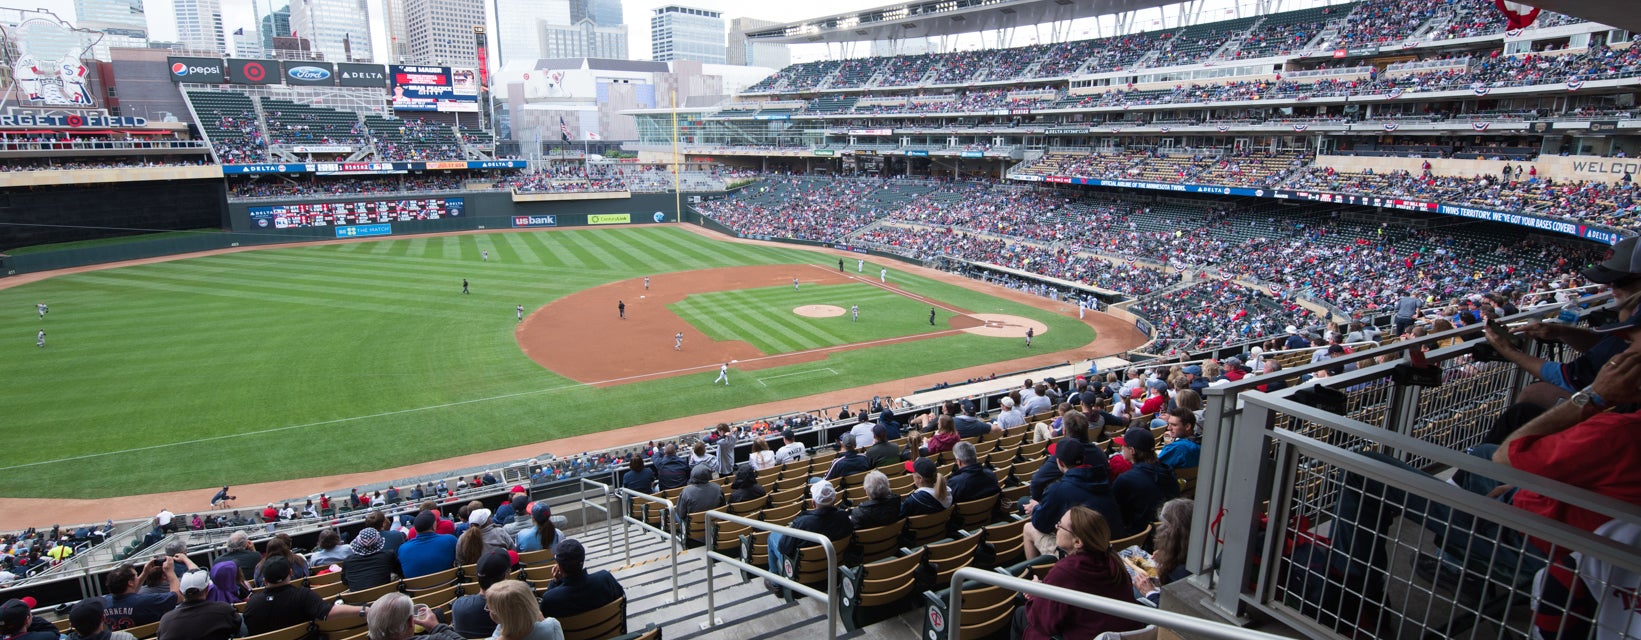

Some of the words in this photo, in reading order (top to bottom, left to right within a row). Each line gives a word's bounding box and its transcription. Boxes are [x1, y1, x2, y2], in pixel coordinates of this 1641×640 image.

[189, 65, 220, 76] pepsi
[296, 68, 322, 79] Ford
[88, 116, 147, 127] FIELD
[1573, 161, 1641, 175] WELCO
[1442, 206, 1459, 215] TWINS
[1510, 216, 1521, 224] GOT
[1521, 217, 1536, 227] YOUR
[1535, 219, 1553, 230] BASES
[1592, 230, 1609, 242] DELTA
[103, 607, 134, 617] ORNEAU
